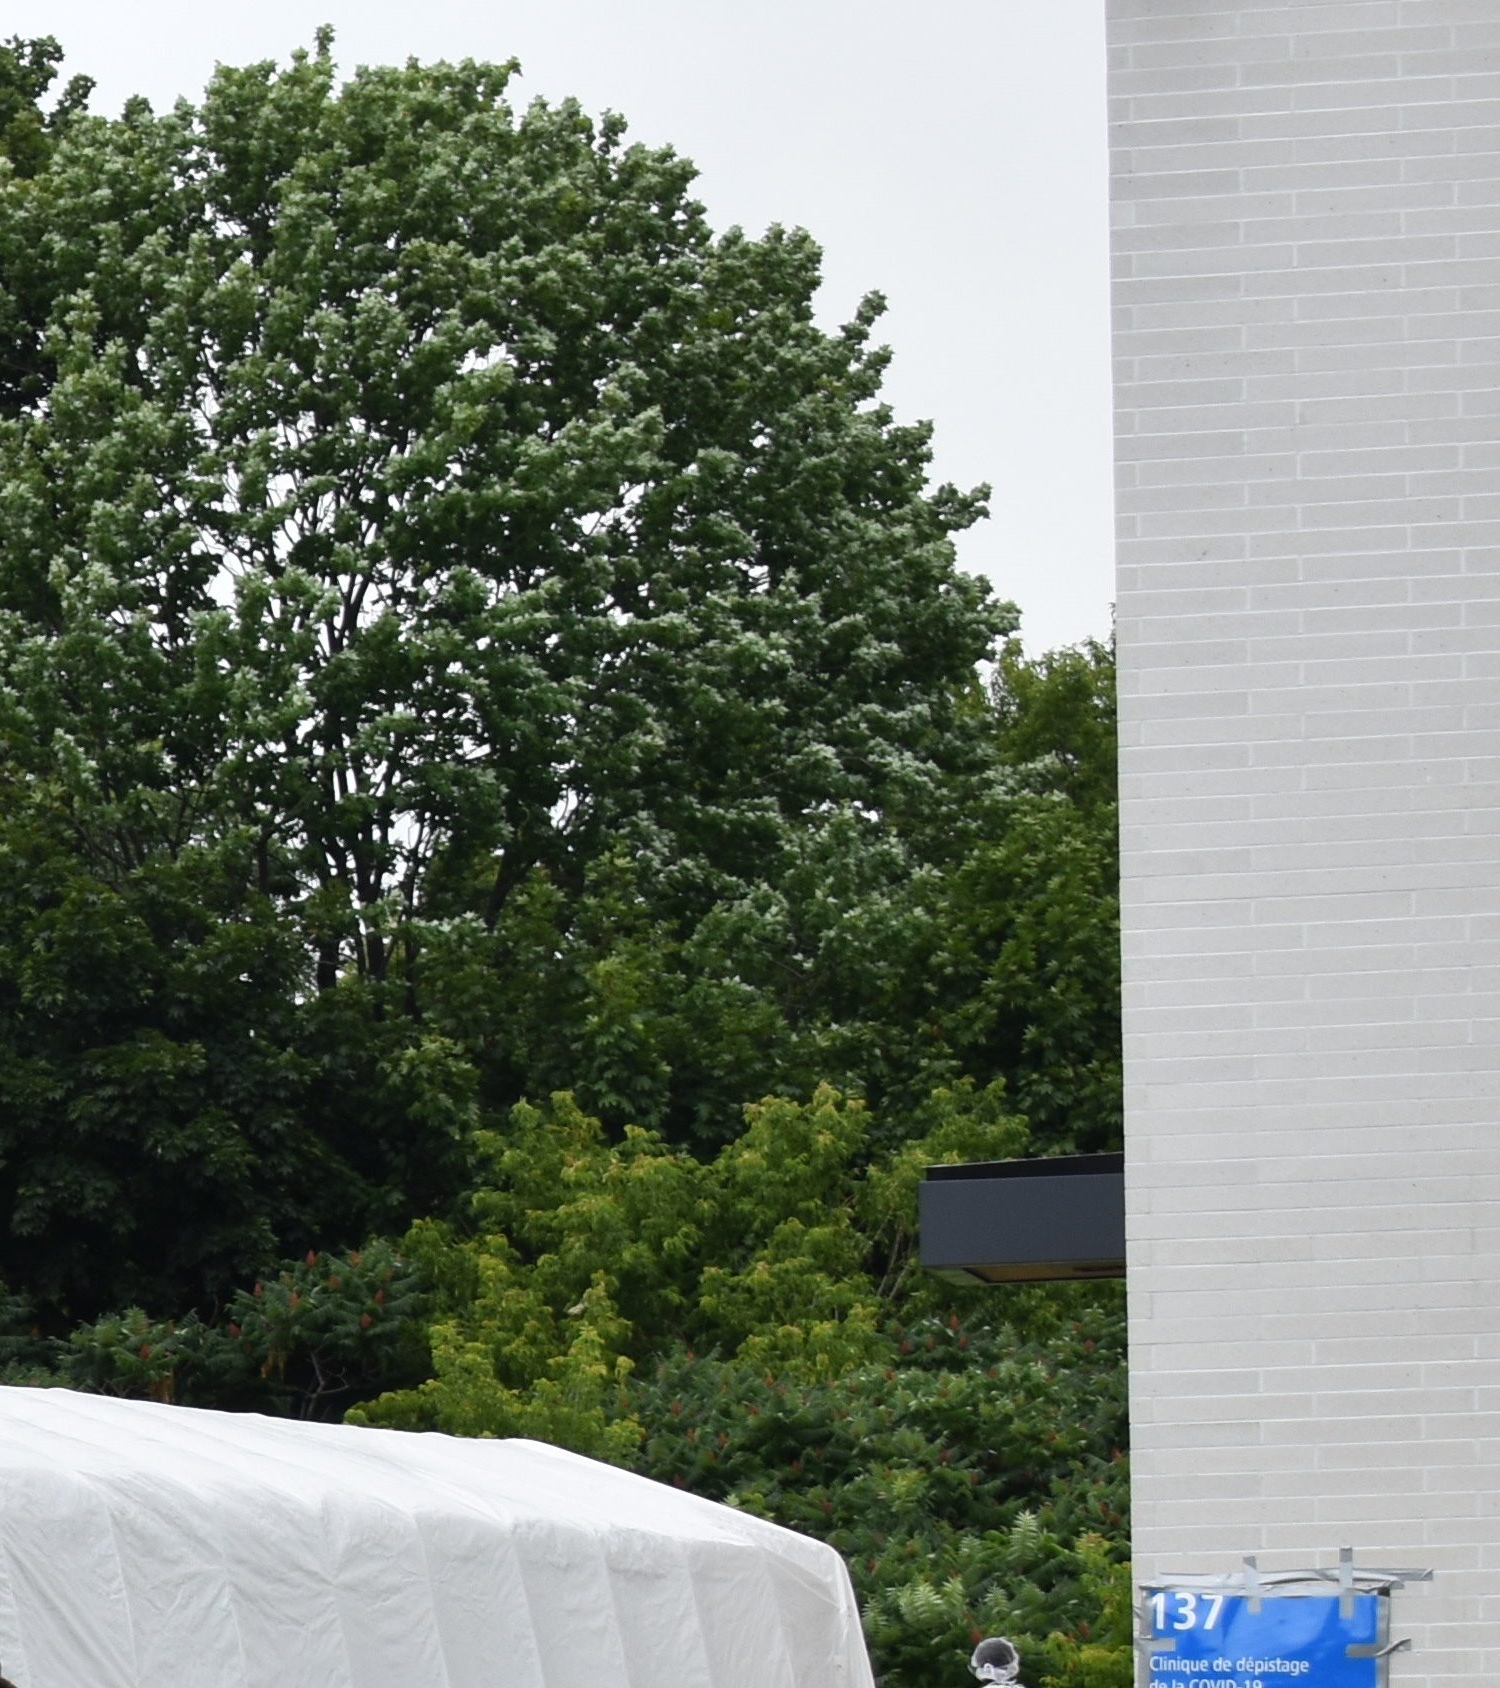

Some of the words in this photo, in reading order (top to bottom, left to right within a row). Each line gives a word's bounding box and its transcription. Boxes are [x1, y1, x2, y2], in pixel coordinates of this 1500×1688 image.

[1150, 1592, 1224, 1630] 137
[1149, 1655, 1209, 1674] Clinique
[1212, 1656, 1232, 1672] de
[1236, 1656, 1310, 1676] dépistage
